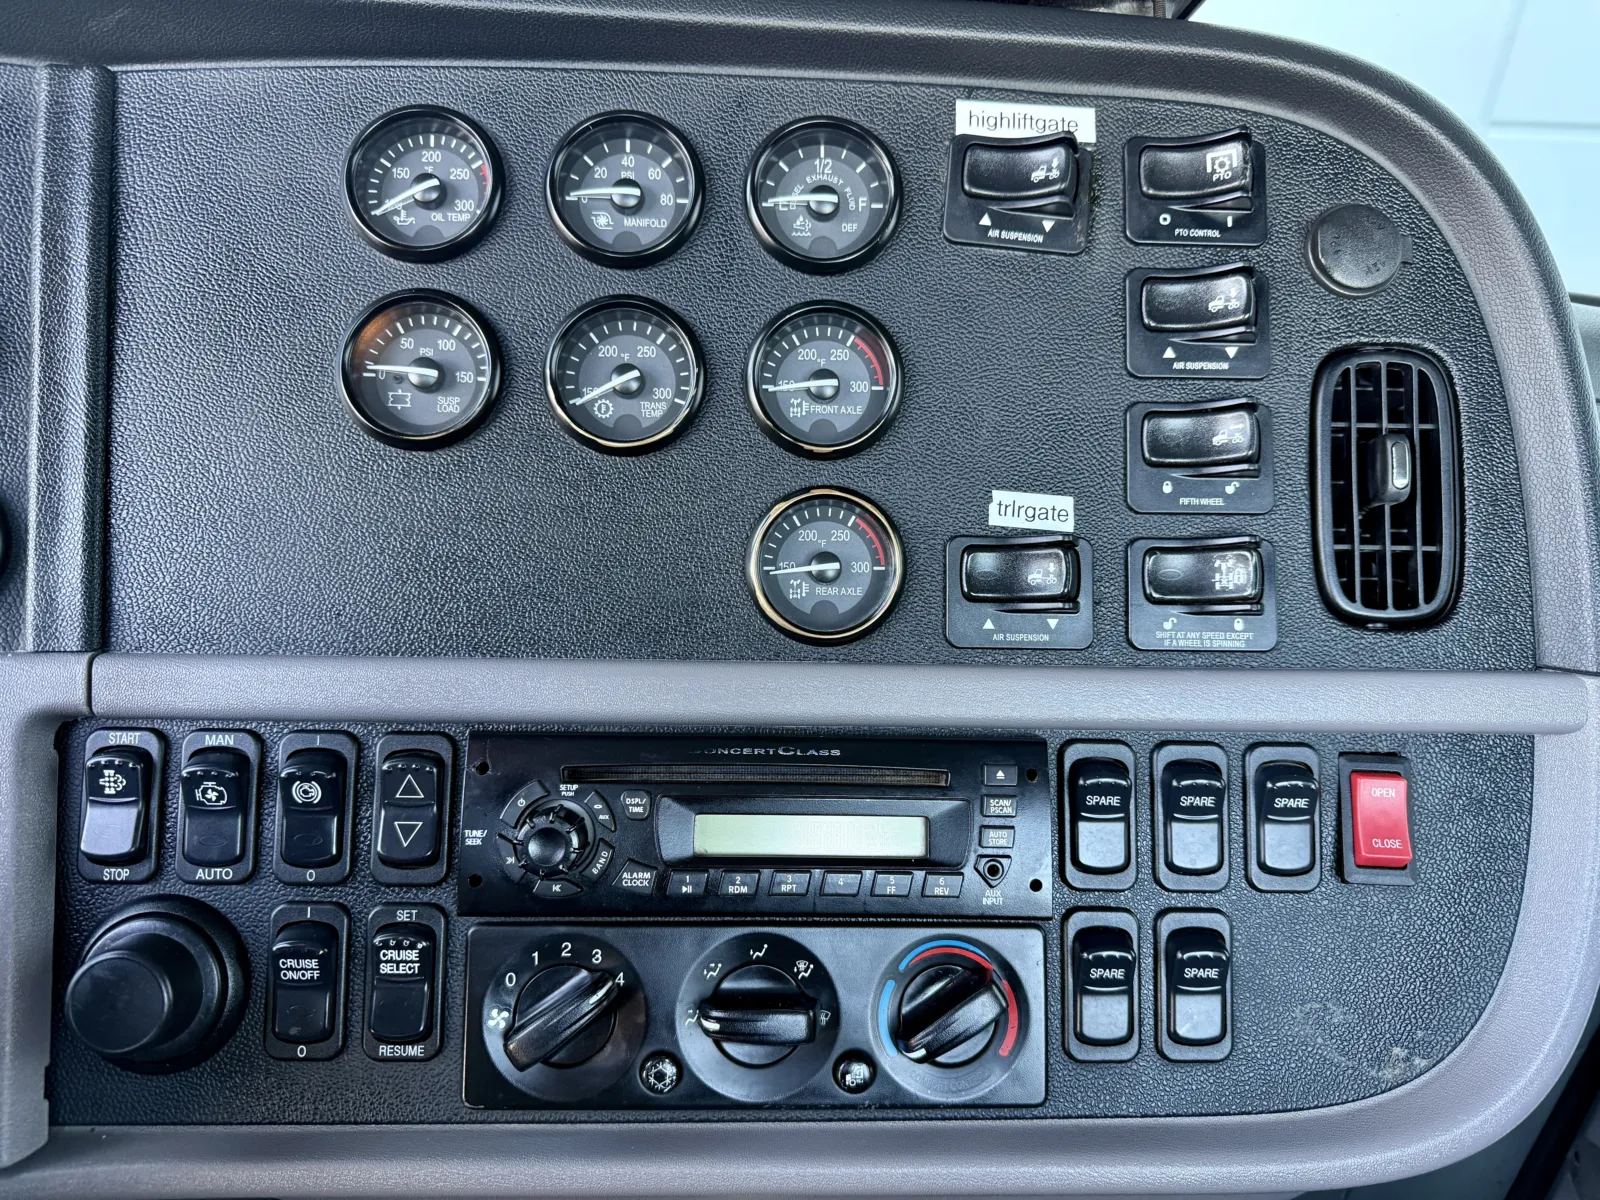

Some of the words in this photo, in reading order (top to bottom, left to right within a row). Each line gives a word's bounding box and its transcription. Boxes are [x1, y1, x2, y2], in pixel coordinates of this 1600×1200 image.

[969, 110, 1079, 134] highliftgate
[421, 151, 441, 162] 200
[621, 156, 635, 167] 40
[814, 158, 832, 174] 1/2
[392, 167, 410, 179] 150
[449, 168, 470, 180] 250
[594, 167, 607, 179] 20
[621, 172, 635, 180] PSI
[648, 169, 661, 180] 60
[1212, 171, 1232, 182] PTO
[805, 174, 844, 186] EXHAUST
[660, 194, 673, 205] 80
[859, 197, 867, 212] F
[454, 200, 474, 211] 300
[431, 213, 445, 221] OIL
[447, 213, 471, 222] TEMP
[624, 217, 667, 228] MANIFOLD
[841, 223, 857, 232] DEF
[1174, 228, 1189, 237] PTO
[1189, 229, 1221, 238] CONTROL
[988, 228, 1000, 238] AIR
[1000, 229, 1044, 243] SUSPENSION
[400, 338, 414, 349] 50
[437, 339, 456, 351] 100
[420, 348, 434, 356] PSI
[598, 345, 618, 357] 200
[637, 346, 656, 358] 250
[797, 349, 817, 361] 200
[830, 349, 849, 361] 250
[1173, 362, 1185, 370] AIR
[1185, 362, 1229, 370] SUSPENSION
[456, 372, 473, 383] 150
[849, 381, 868, 393] 300
[652, 388, 672, 399] 300
[437, 396, 460, 405] SUSP
[640, 401, 667, 410] TRANS
[437, 405, 460, 413] LOAD
[641, 410, 664, 418] TEMP
[810, 406, 839, 415] FRONT
[841, 405, 862, 415] AXLE
[1179, 498, 1200, 506] FIFTH
[1200, 498, 1224, 506] WHEEL
[798, 530, 817, 541] 200
[830, 530, 850, 542] 250
[851, 561, 870, 572] 300
[816, 587, 839, 595] REAR
[840, 587, 863, 595] AXLE
[992, 633, 1006, 642] AIR
[1007, 633, 1049, 642] SUSPENSION
[1155, 631, 1177, 639] SHIFT
[1176, 631, 1186, 639] AT
[1186, 631, 1201, 639] ANY
[1226, 632, 1254, 640] EXCEPT
[1164, 639, 1171, 647] IF
[1212, 640, 1246, 648] SPINNING
[108, 732, 140, 745] START
[205, 735, 234, 746] MAN
[1371, 787, 1395, 798] OPEN
[1085, 795, 1121, 806] SPARE
[1179, 796, 1215, 807] SPARE
[1273, 797, 1309, 809] SPARE
[990, 806, 1012, 814] PSCAN
[465, 837, 482, 845] SEEK
[988, 838, 1008, 846] STORE
[1372, 838, 1402, 849] CLOSE
[591, 850, 609, 875] BAND
[103, 869, 130, 881] STOP
[195, 868, 233, 880] AUTO
[685, 875, 690, 883] 1
[787, 875, 792, 883] 3
[735, 876, 741, 884] 2
[838, 878, 844, 886] 4
[889, 876, 895, 884] 5
[939, 877, 945, 885] 6
[887, 886, 896, 894] FF
[934, 887, 950, 895] REV
[984, 889, 1002, 897] AUX
[982, 897, 1003, 905] INPUT
[396, 910, 418, 921] SET
[561, 942, 572, 957] 2
[380, 950, 419, 961] CRUISE
[531, 951, 539, 966] 1
[591, 949, 602, 964] 3
[279, 959, 319, 969] CRUISE
[380, 963, 420, 974] SELECT
[280, 970, 320, 980] ON/OFF
[615, 972, 625, 986] 4
[1089, 968, 1125, 979] SPARE
[1183, 968, 1219, 979] SPARE
[378, 1045, 425, 1056] RESUME
